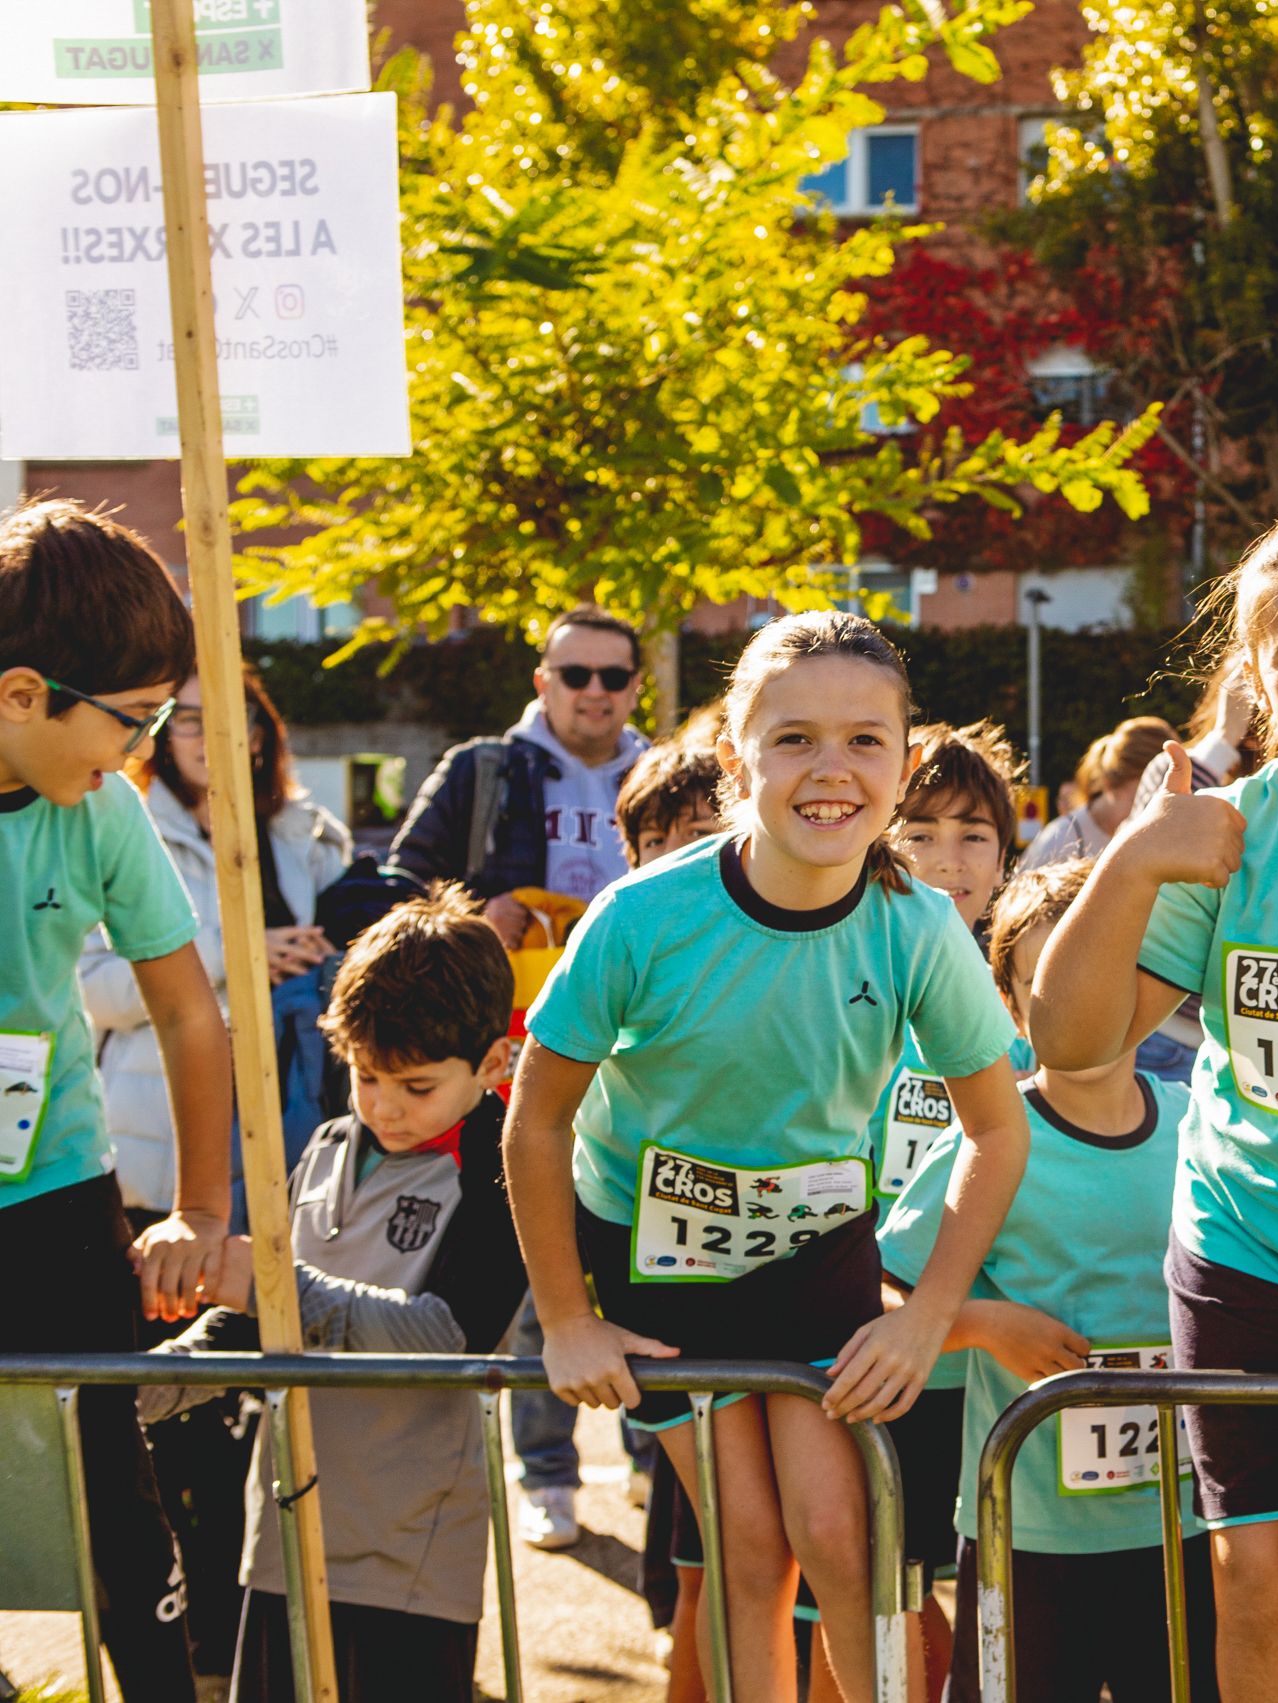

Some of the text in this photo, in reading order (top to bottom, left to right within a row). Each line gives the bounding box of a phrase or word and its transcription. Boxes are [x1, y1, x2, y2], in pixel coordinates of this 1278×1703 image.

[1240, 1007, 1264, 1018] Ciutat
[1264, 1010, 1275, 1019] de
[898, 1096, 949, 1121] CROS
[655, 1172, 733, 1208] CROS
[679, 1196, 690, 1205] de
[691, 1200, 708, 1210] Sant
